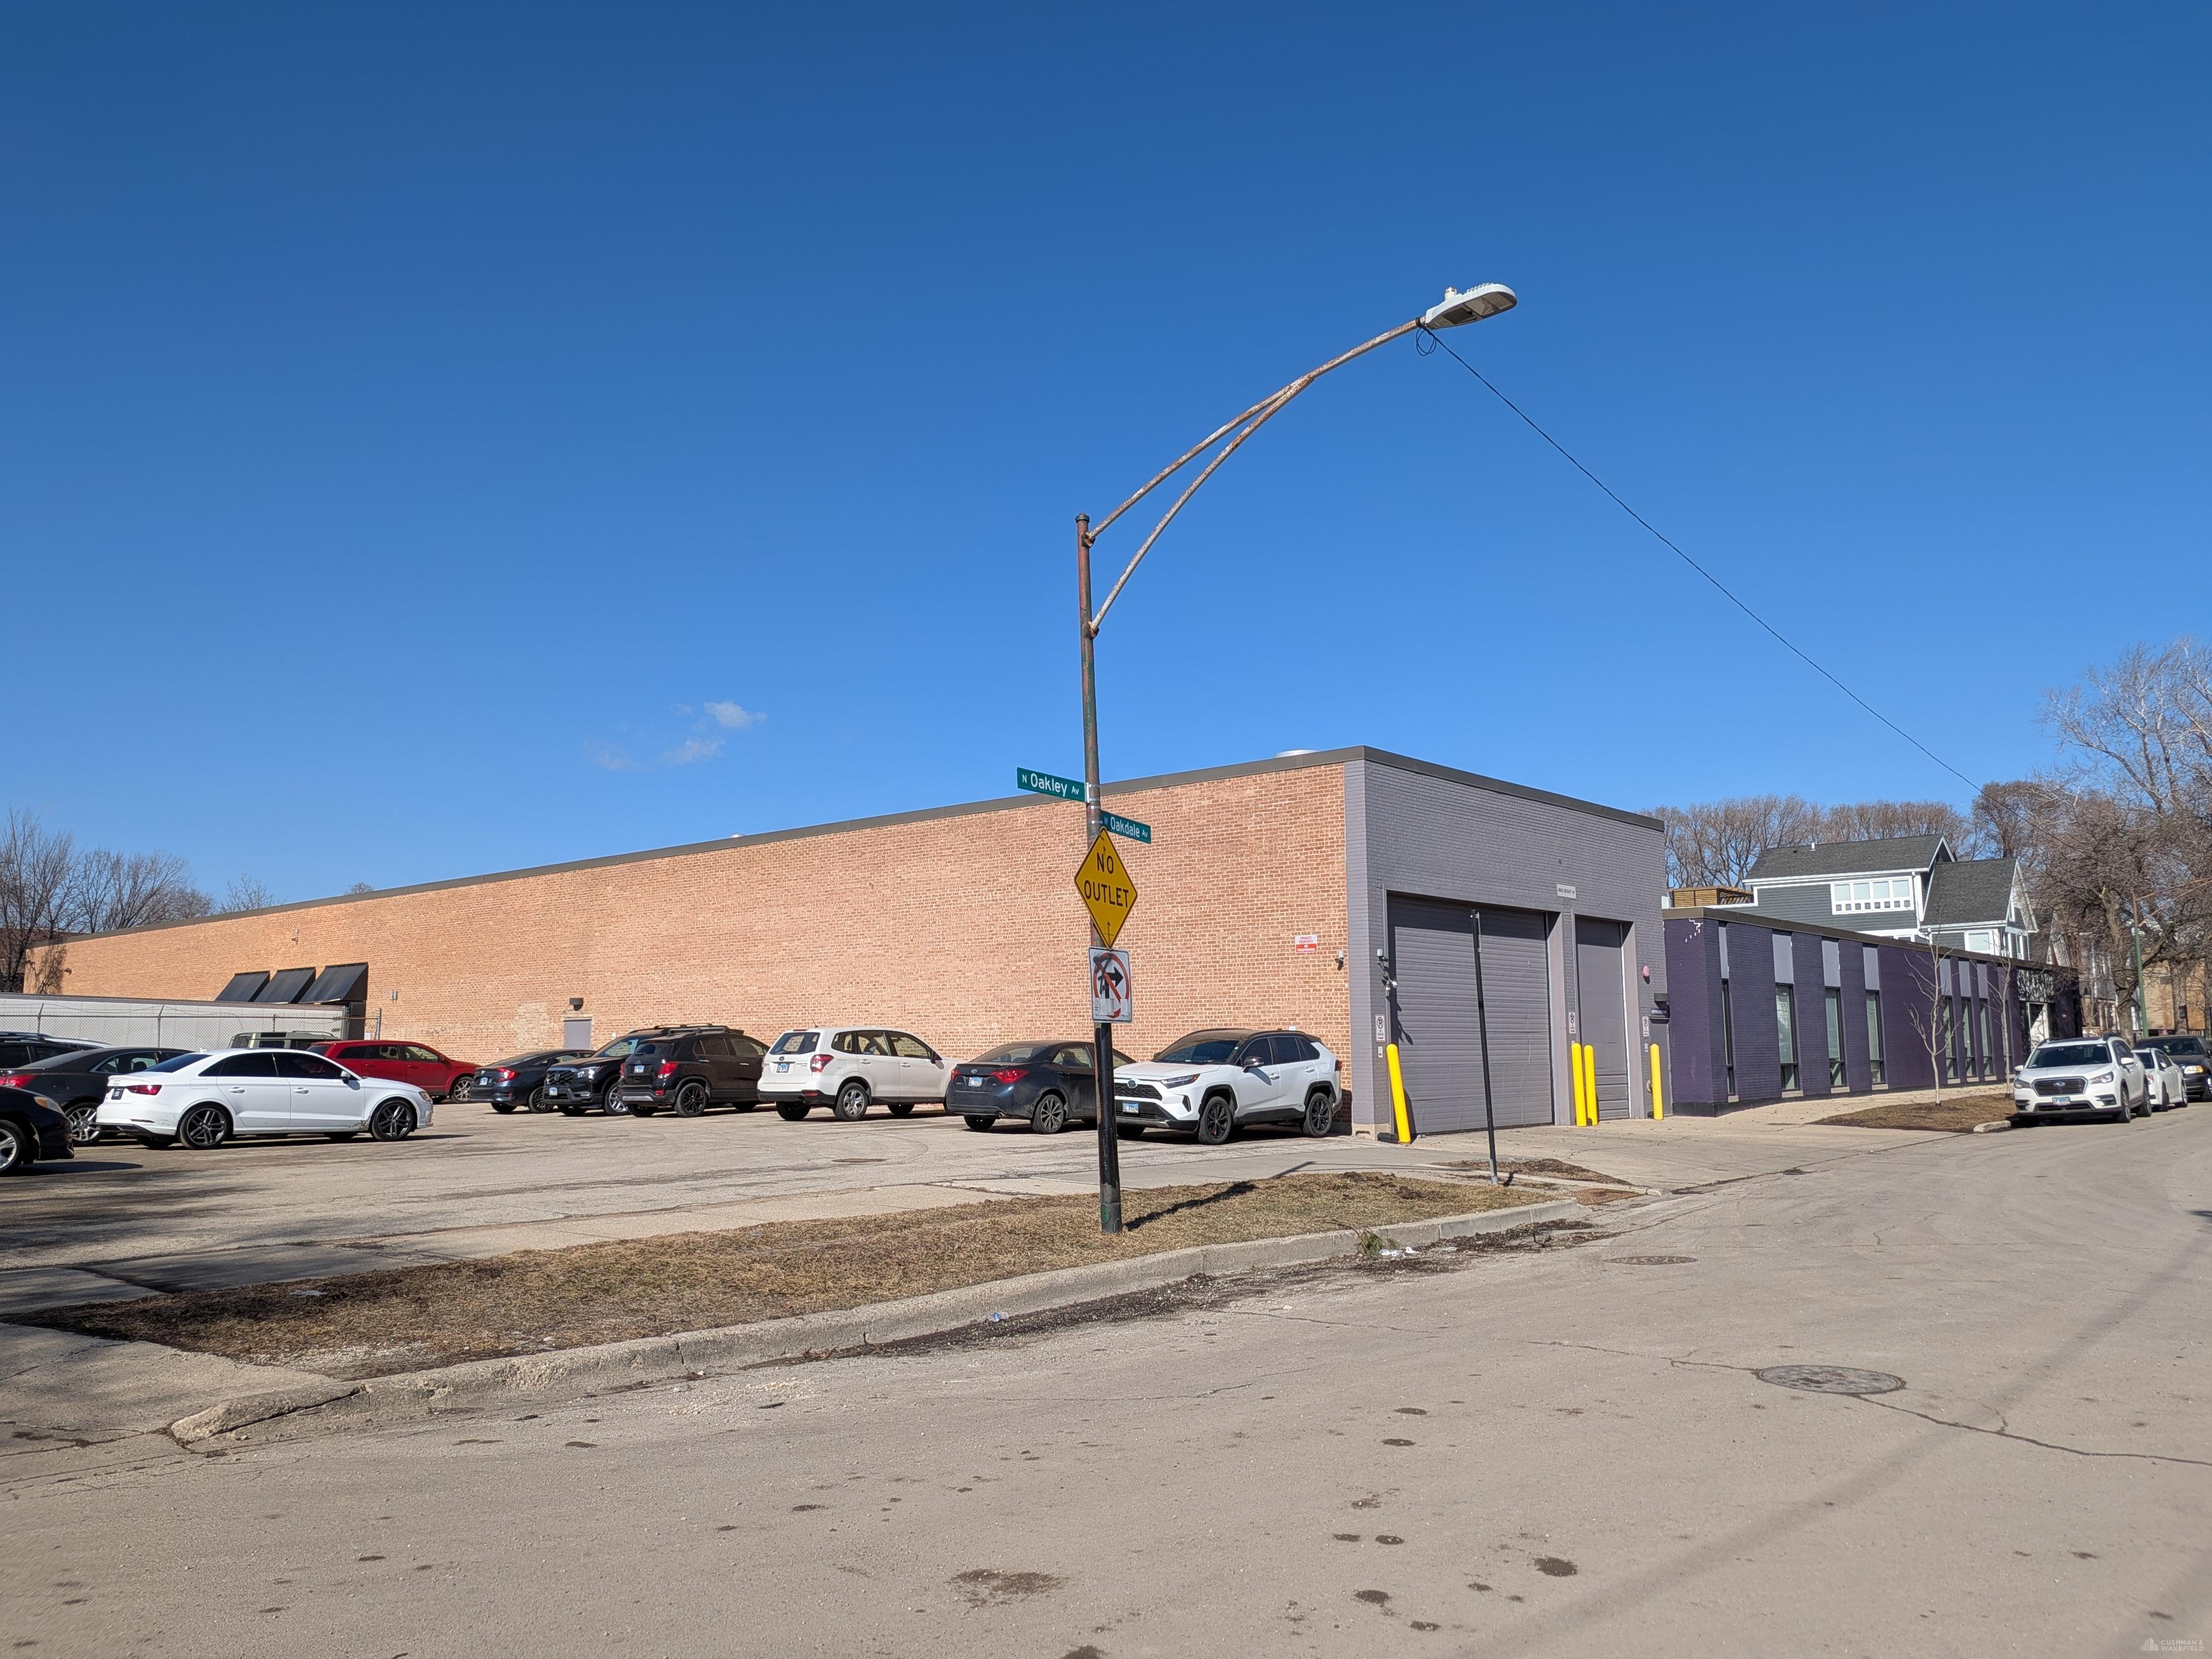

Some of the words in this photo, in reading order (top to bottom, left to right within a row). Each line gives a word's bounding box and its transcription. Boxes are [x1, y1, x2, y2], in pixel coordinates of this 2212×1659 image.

[1022, 774, 1027, 783] N
[1030, 773, 1067, 797] Oakley
[1071, 786, 1079, 795] Av
[1104, 816, 1108, 825] W
[1110, 816, 1140, 838] Oakdale
[1142, 829, 1148, 838] Av
[1097, 852, 1114, 874] NO
[1084, 880, 1129, 908] OUTLET
